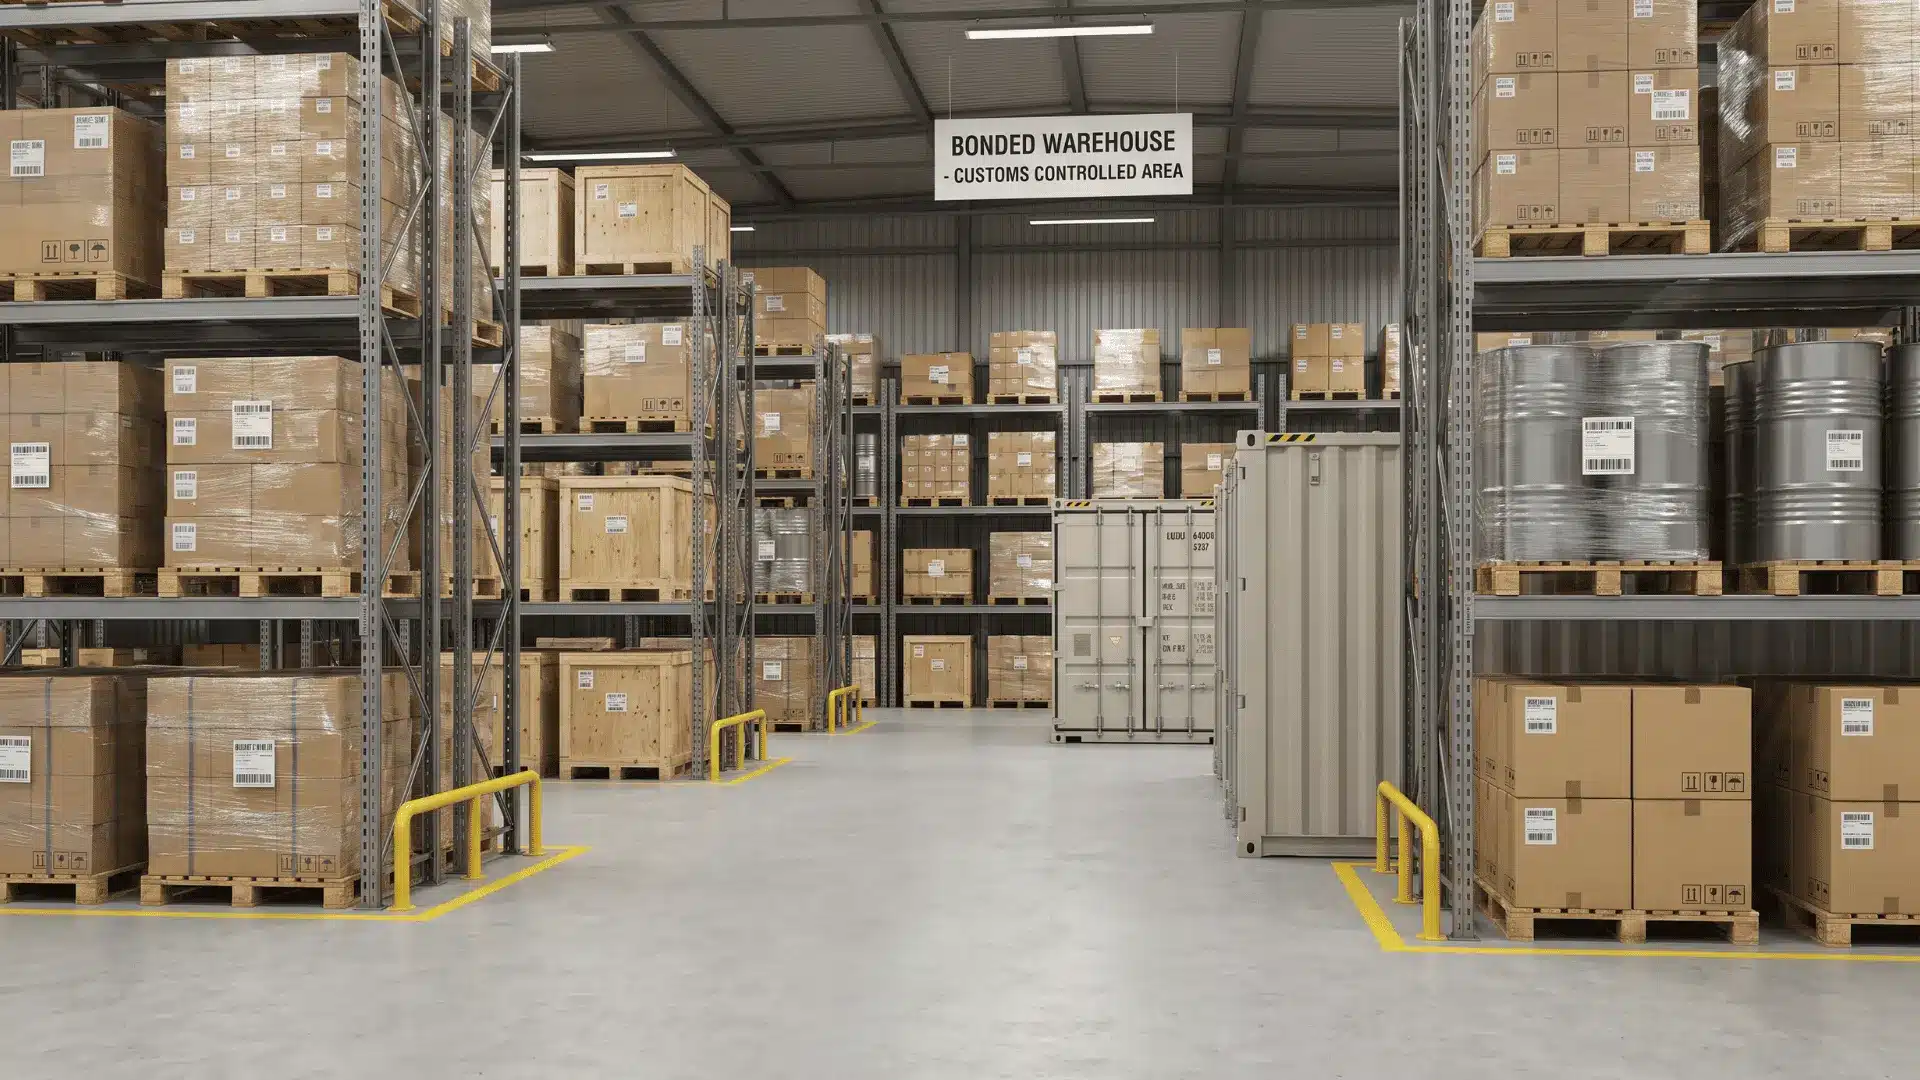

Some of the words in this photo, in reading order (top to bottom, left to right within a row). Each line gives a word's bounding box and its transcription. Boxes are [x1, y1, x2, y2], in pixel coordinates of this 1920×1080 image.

[951, 134, 1036, 157] BONDED
[1042, 130, 1176, 154] WAREHOUSE
[954, 166, 1030, 183] CUSTOMS
[1034, 164, 1137, 181] CONTROLLED
[1141, 163, 1184, 179] AREA
